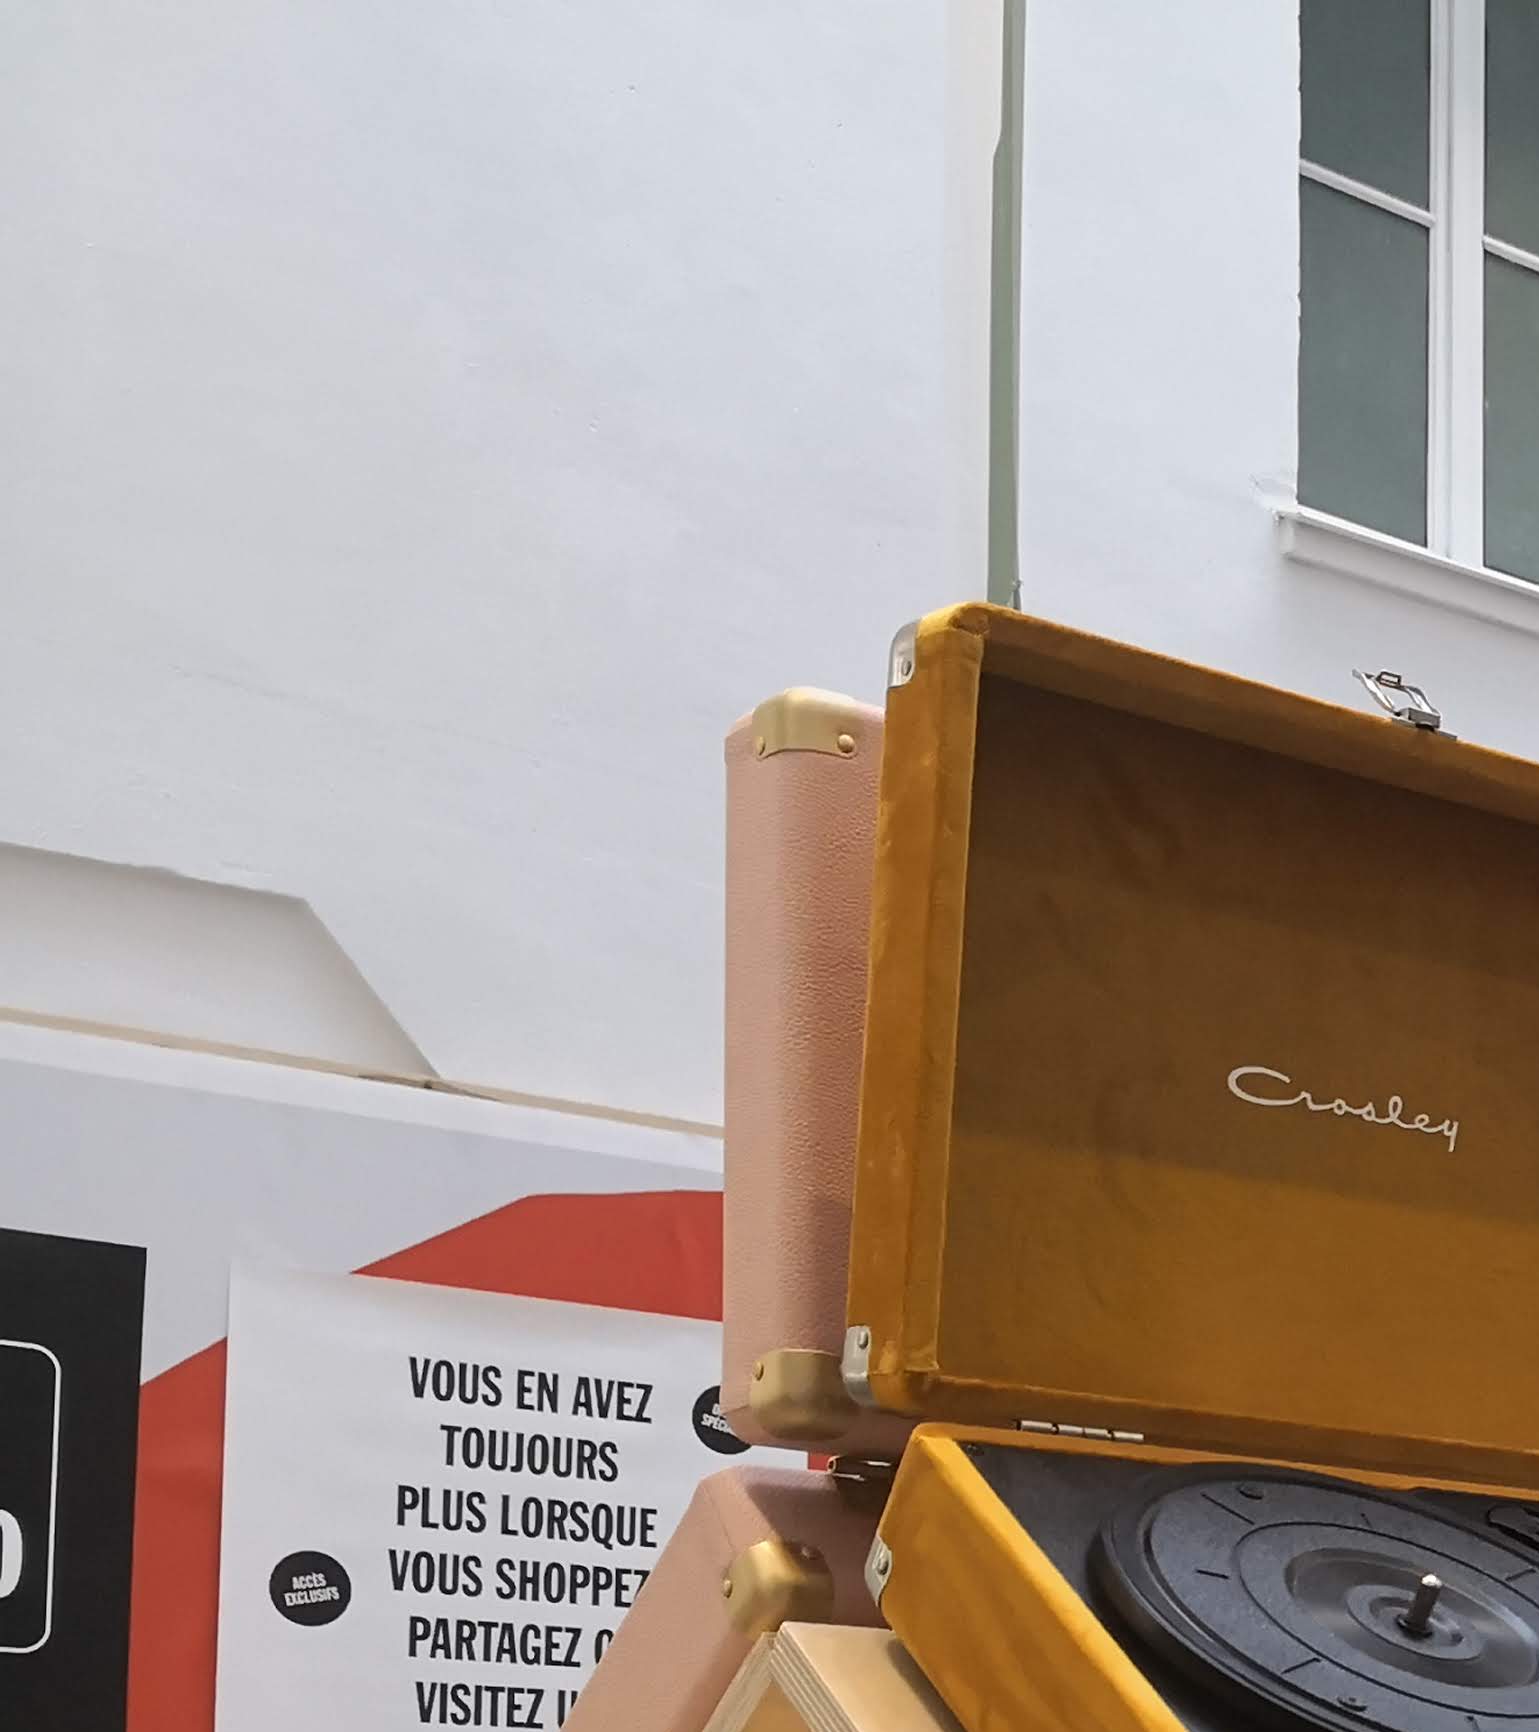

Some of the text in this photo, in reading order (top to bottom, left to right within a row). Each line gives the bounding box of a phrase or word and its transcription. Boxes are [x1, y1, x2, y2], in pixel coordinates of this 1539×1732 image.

[1227, 1066, 1459, 1152] Crosley
[409, 1356, 654, 1424] VOUS EN AVEZ
[440, 1424, 619, 1482] TOUJOURS
[397, 1484, 658, 1550] PLUS LORSQUE
[388, 1548, 483, 1597] VOUS
[408, 1616, 582, 1667] PARTAGEZ
[415, 1681, 544, 1729] VISITEZ
